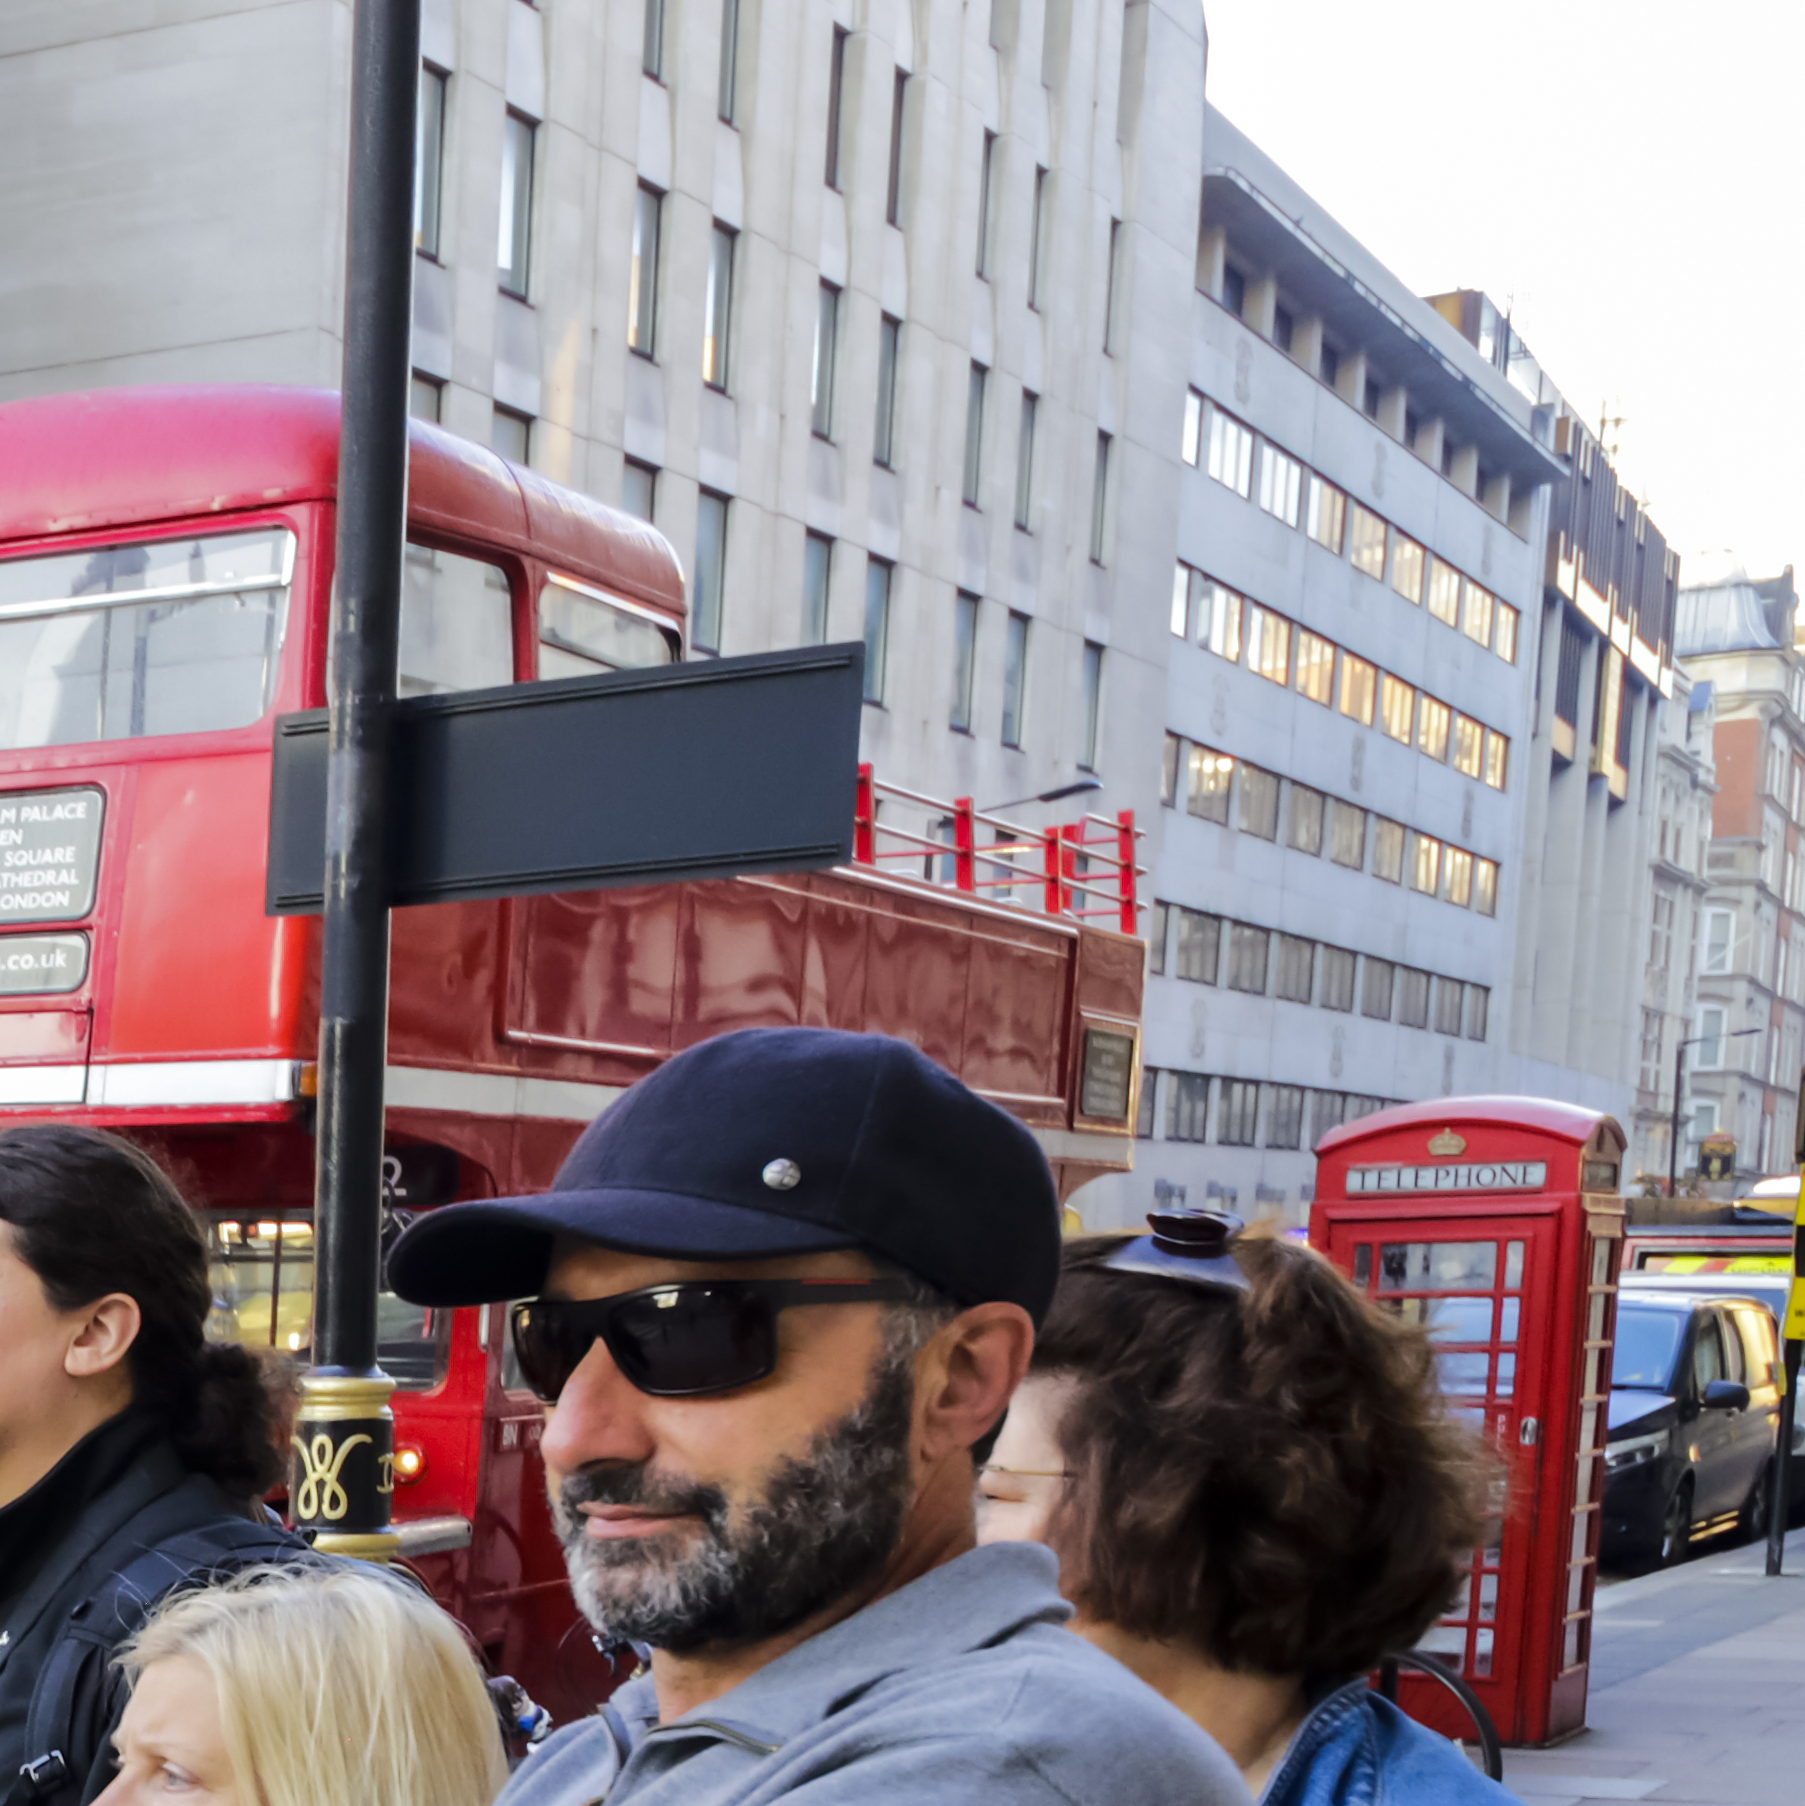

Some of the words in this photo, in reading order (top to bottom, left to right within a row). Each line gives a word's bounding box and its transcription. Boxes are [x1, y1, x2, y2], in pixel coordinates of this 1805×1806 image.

[20, 802, 88, 823] PALACE
[3, 846, 77, 868] SQUARE
[1358, 1164, 1535, 1191] TELEPHONE
